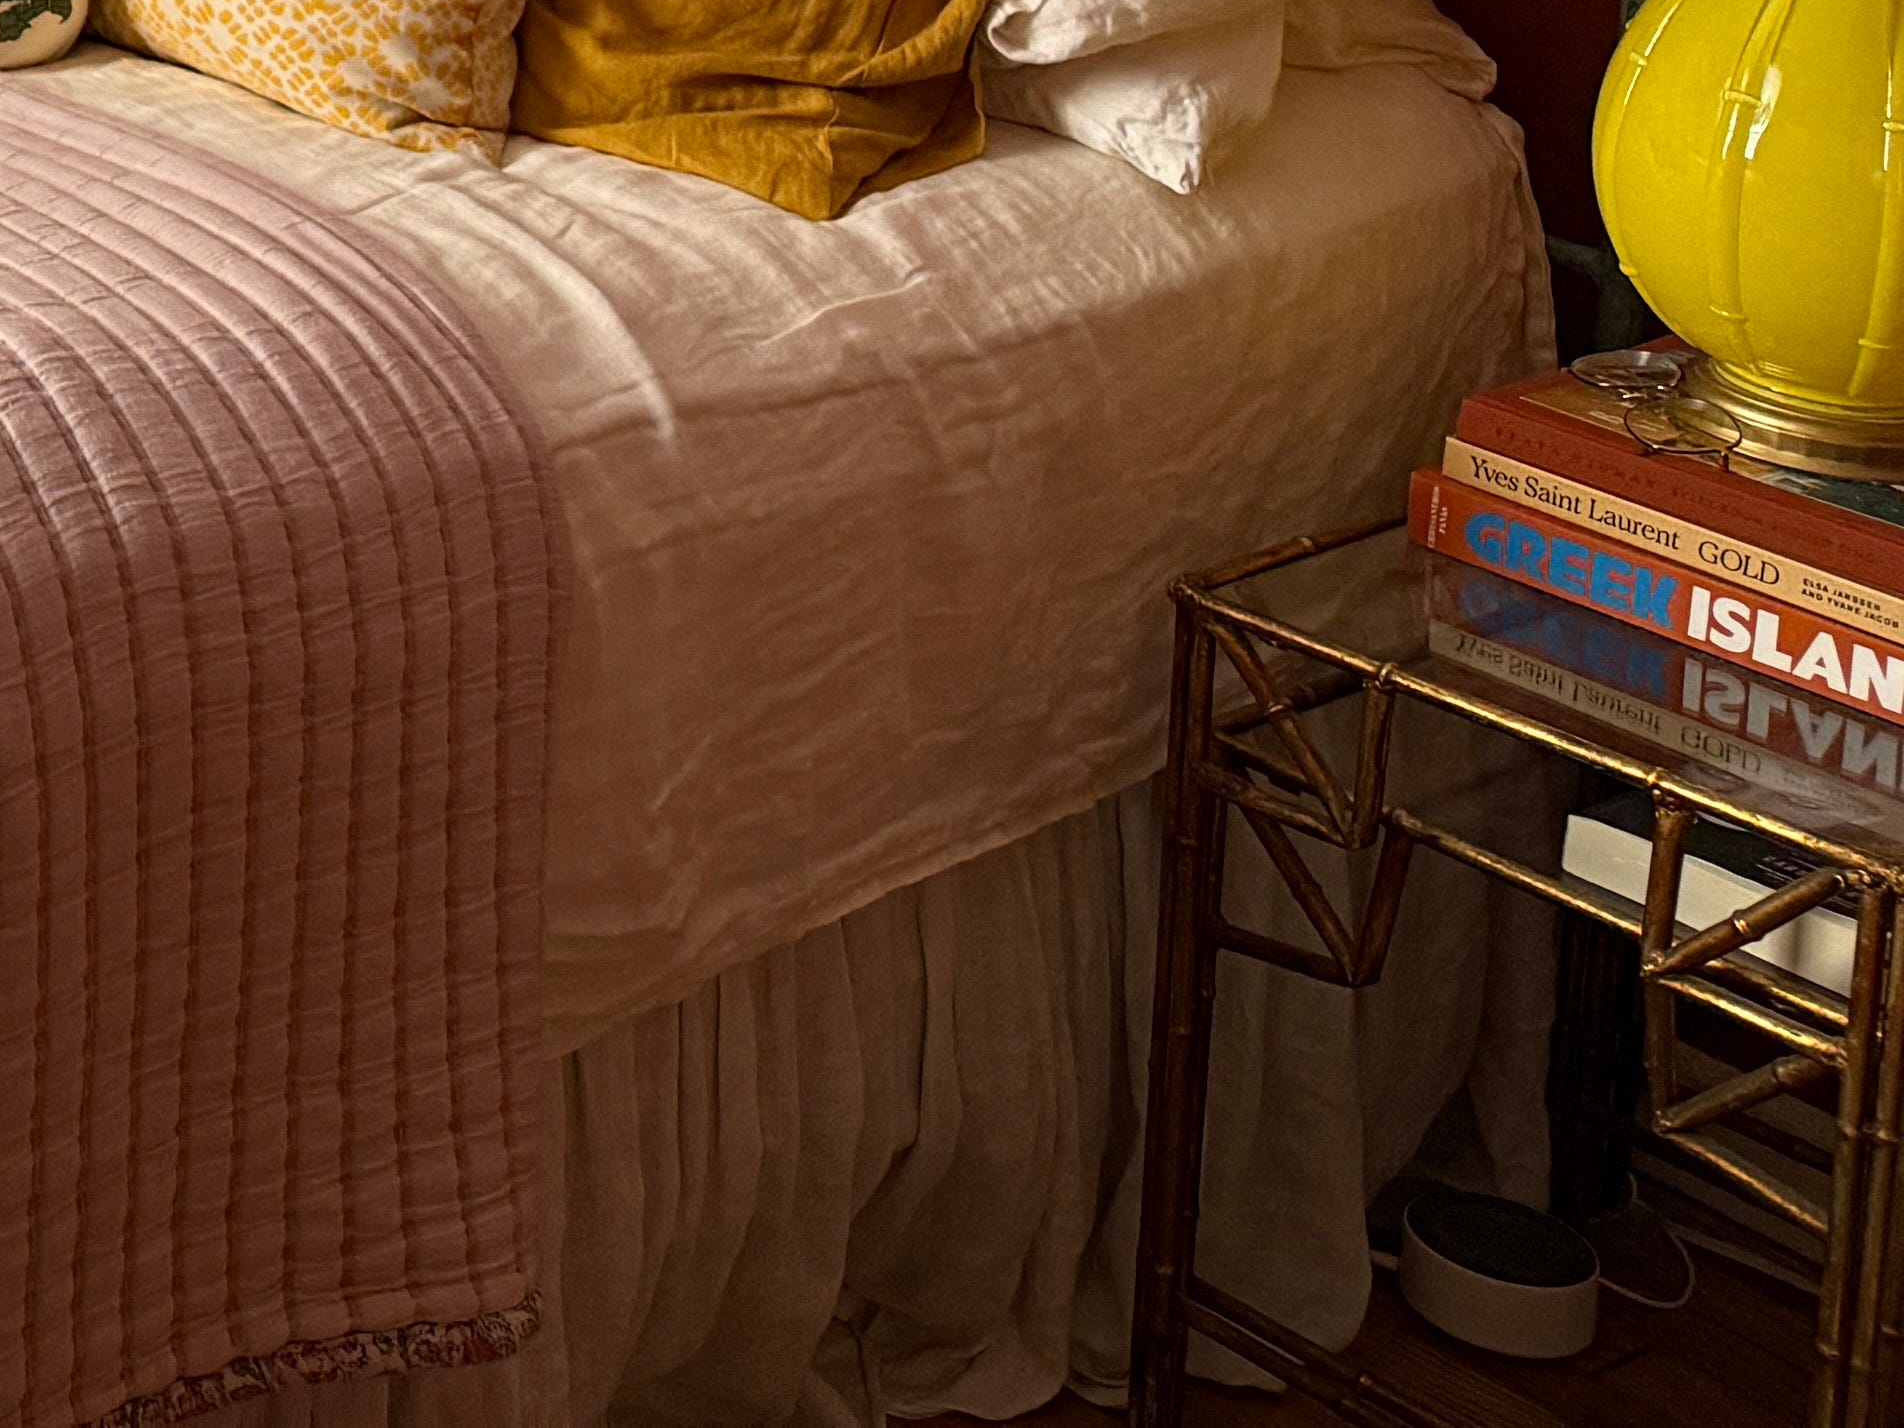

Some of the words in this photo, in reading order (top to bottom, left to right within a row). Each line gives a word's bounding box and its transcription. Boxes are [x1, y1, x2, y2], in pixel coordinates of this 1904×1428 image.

[1470, 455, 1519, 493] Yves
[1523, 476, 1581, 515] Saint
[1587, 498, 1680, 551] Laurent
[1697, 540, 1781, 586] GOLD
[1463, 511, 1680, 630] GREEK
[1687, 586, 1904, 715] ISLAN
[1801, 589, 1823, 602] AND
[1827, 598, 1861, 615] YVANE
[1864, 612, 1899, 628] JACOB
[1803, 578, 1829, 592] ELSA
[1833, 588, 1881, 611] JANSSEN
